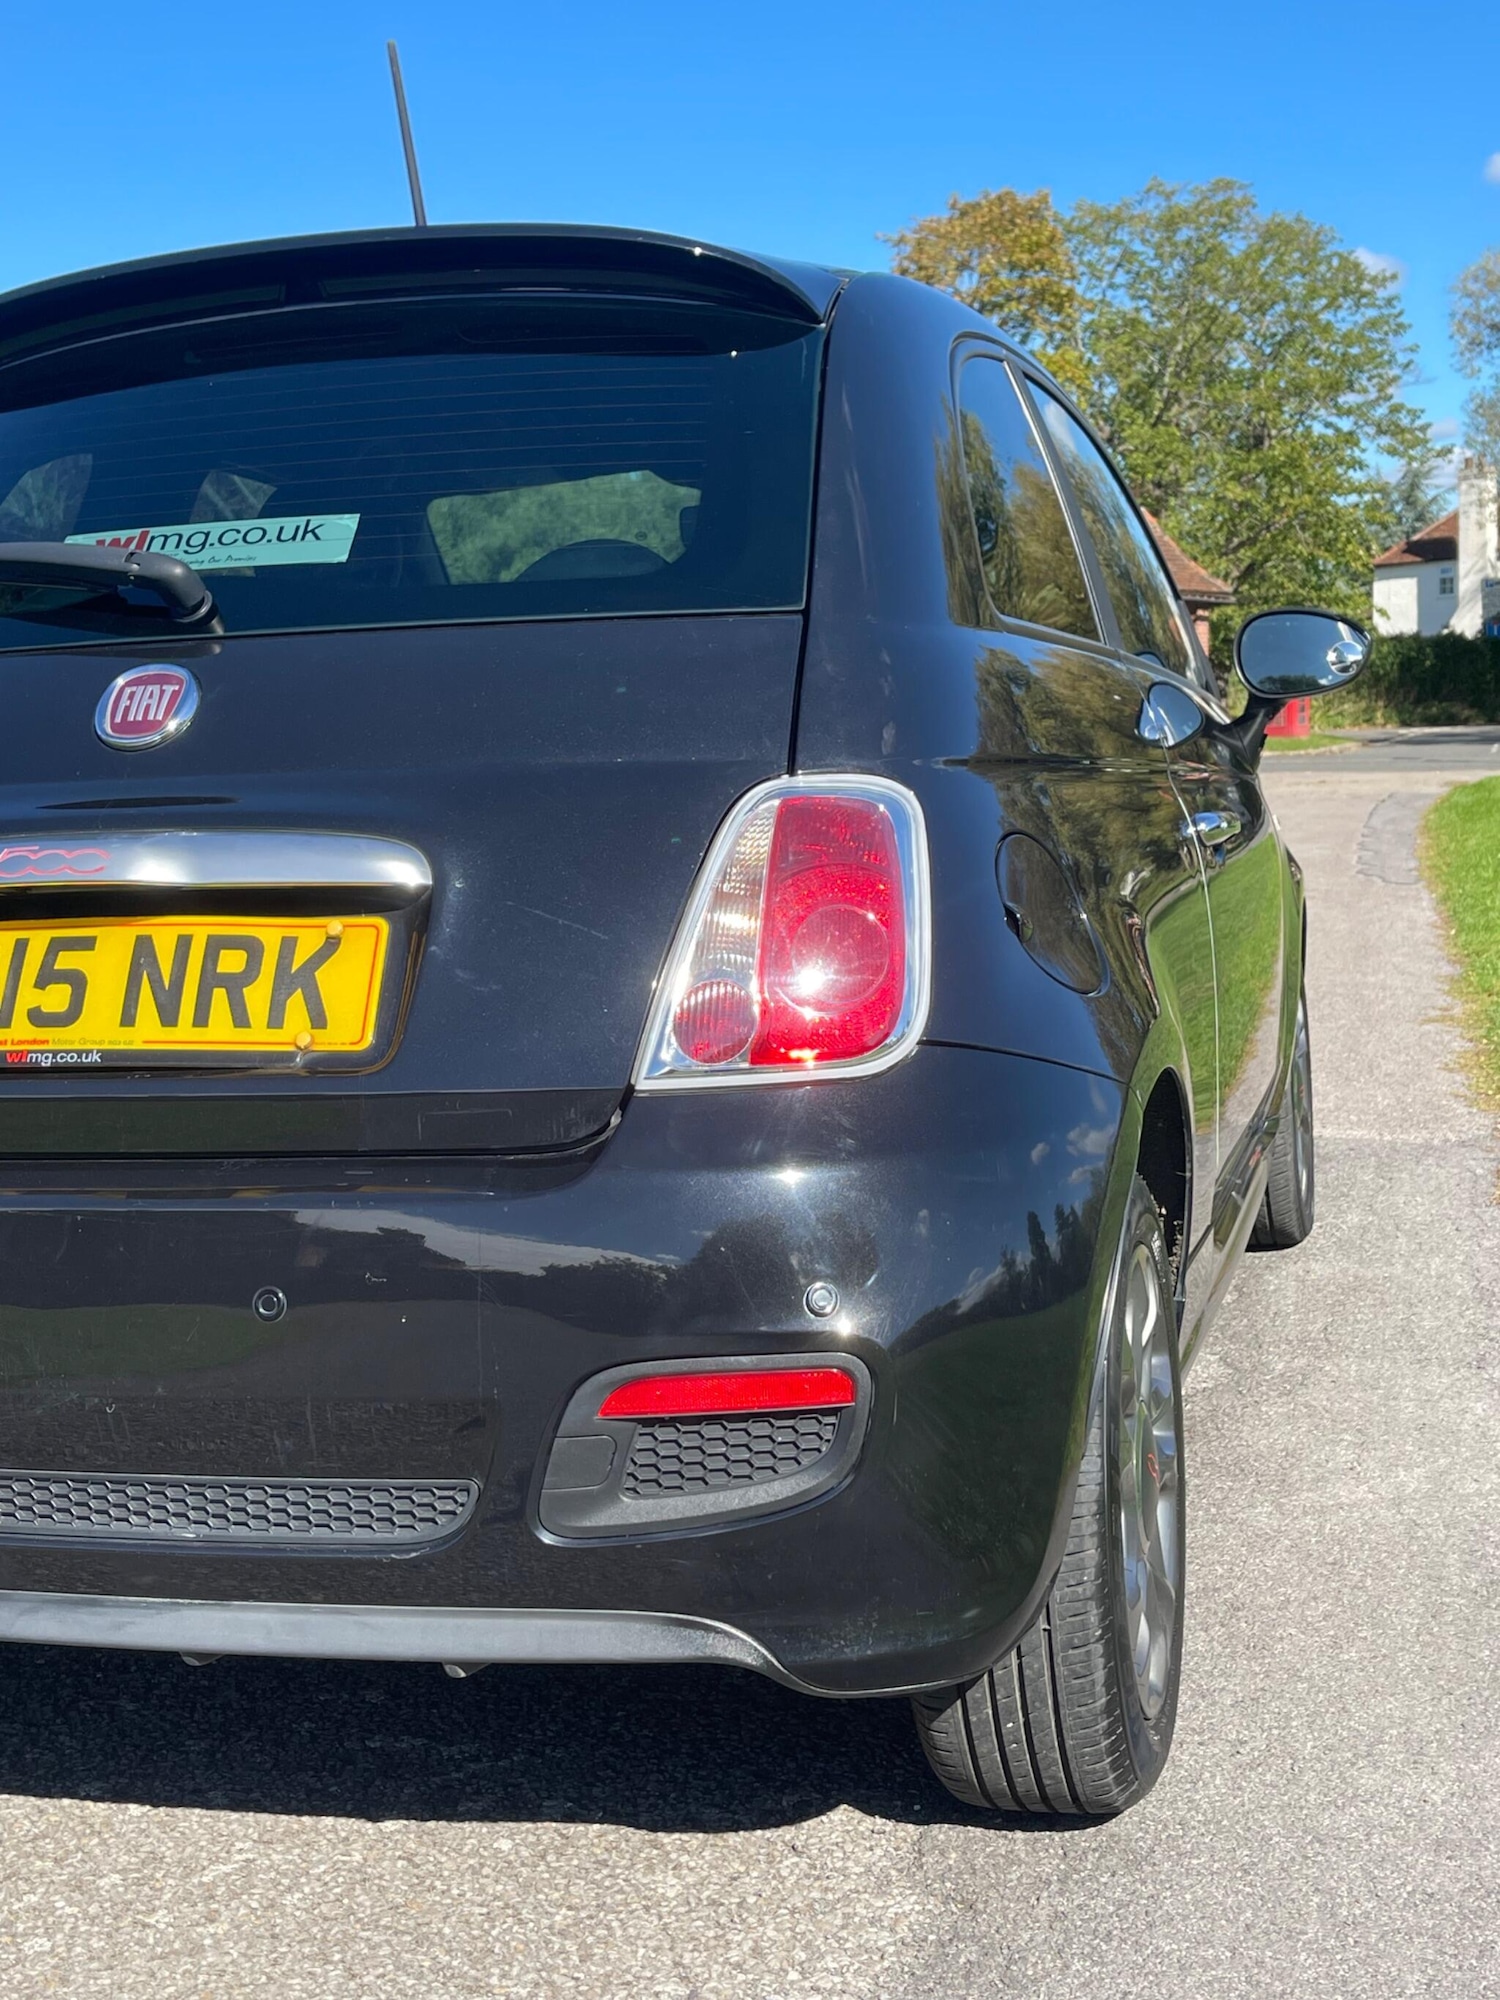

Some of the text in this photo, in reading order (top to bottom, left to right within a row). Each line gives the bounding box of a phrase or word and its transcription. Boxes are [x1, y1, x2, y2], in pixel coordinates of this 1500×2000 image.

[114, 684, 180, 723] FIAT
[119, 934, 342, 1029] NRK
[11, 1038, 50, 1046] London
[79, 1037, 106, 1047] Group
[6, 1049, 102, 1067] wlmg.co.uk
